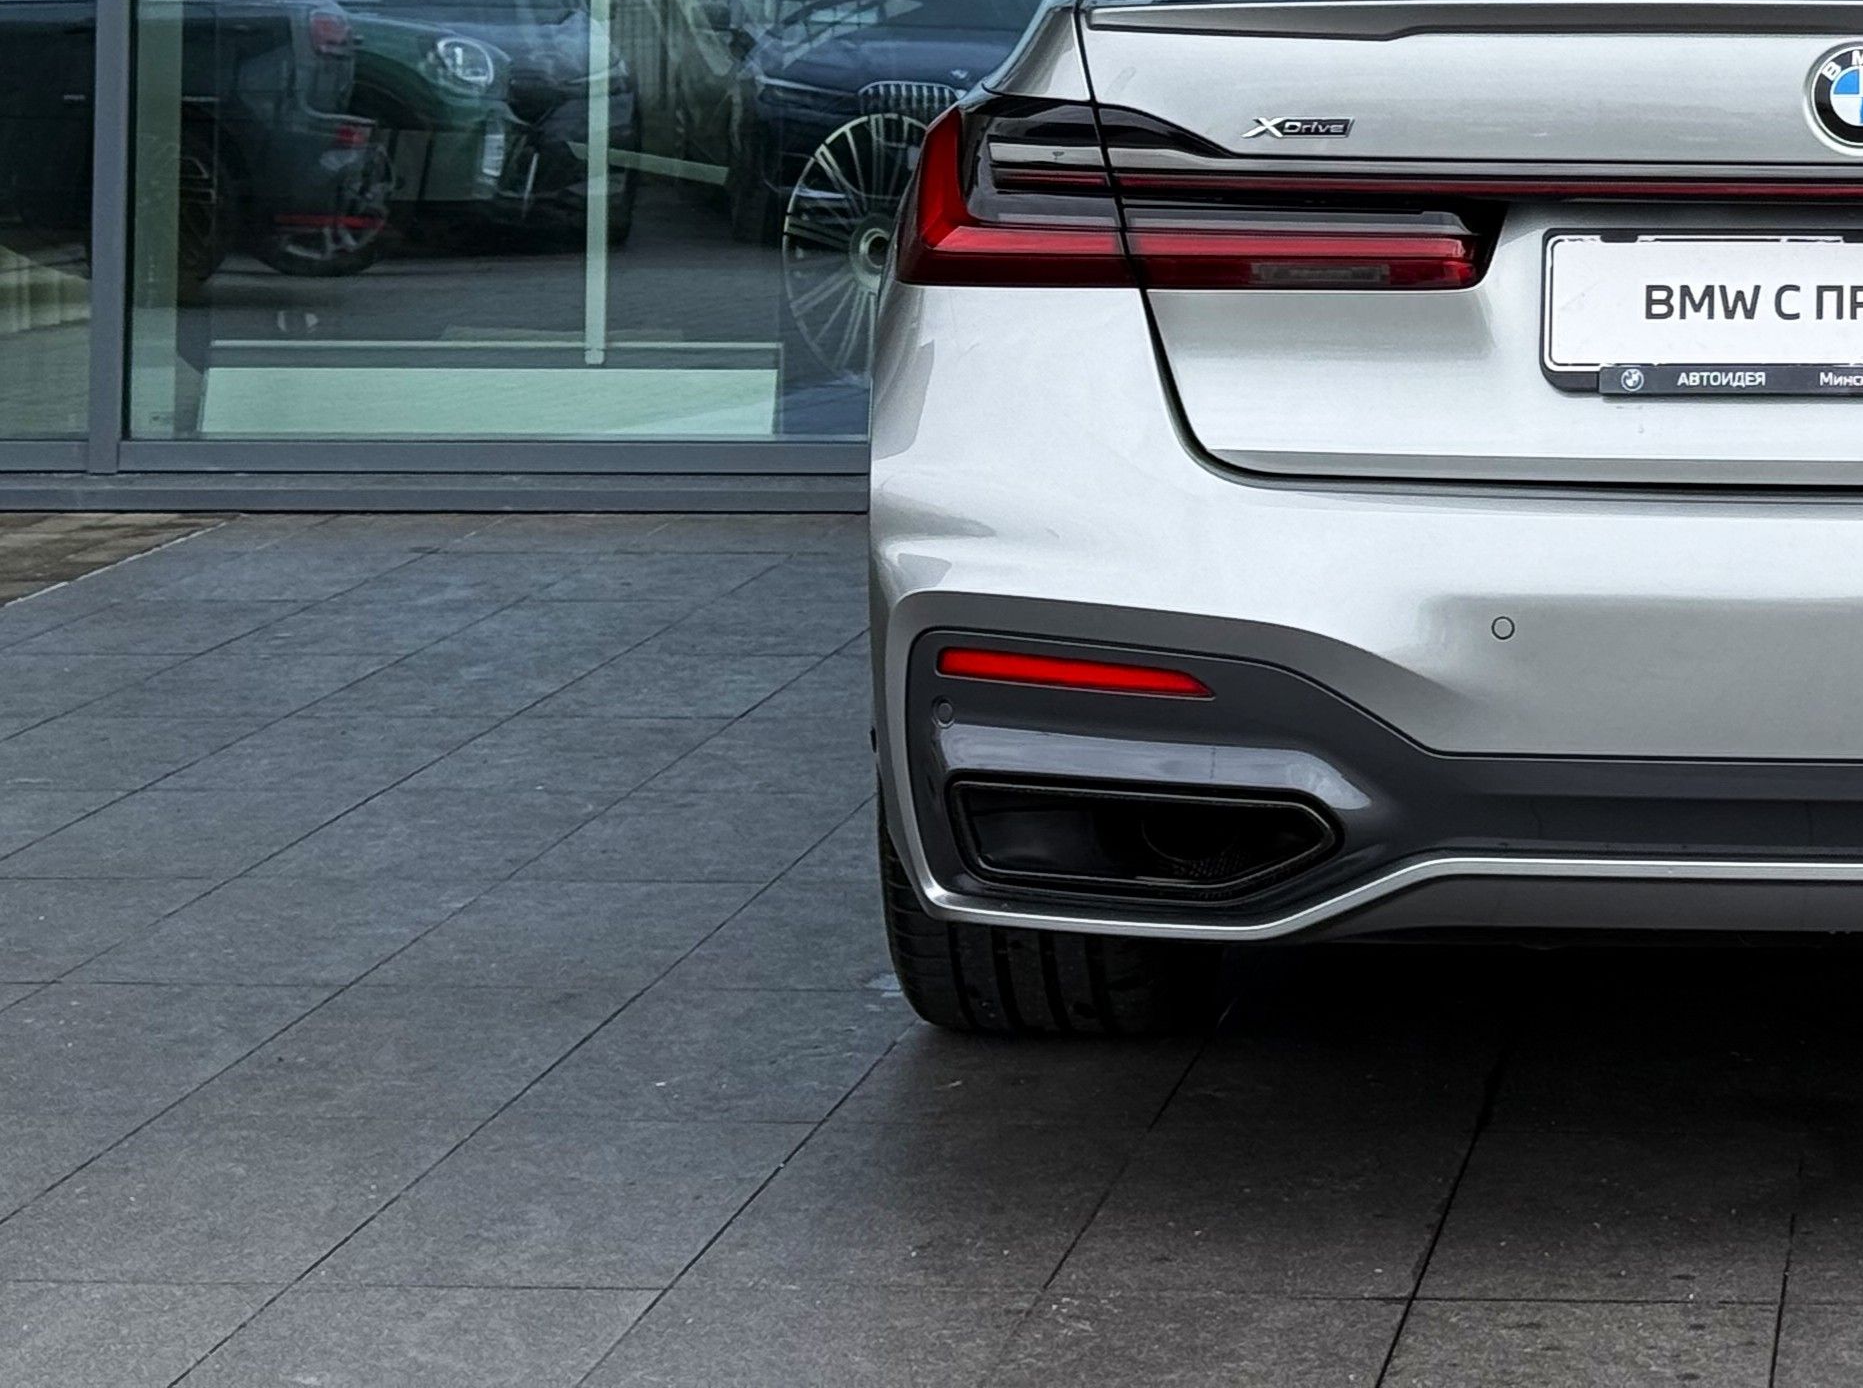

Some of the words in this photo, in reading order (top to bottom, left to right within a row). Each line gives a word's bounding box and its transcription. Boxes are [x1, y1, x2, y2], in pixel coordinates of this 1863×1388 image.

[1645, 285, 1761, 320] BMW
[1774, 285, 1802, 321] С
[1677, 371, 1766, 388] АВТОИДЕЯ
